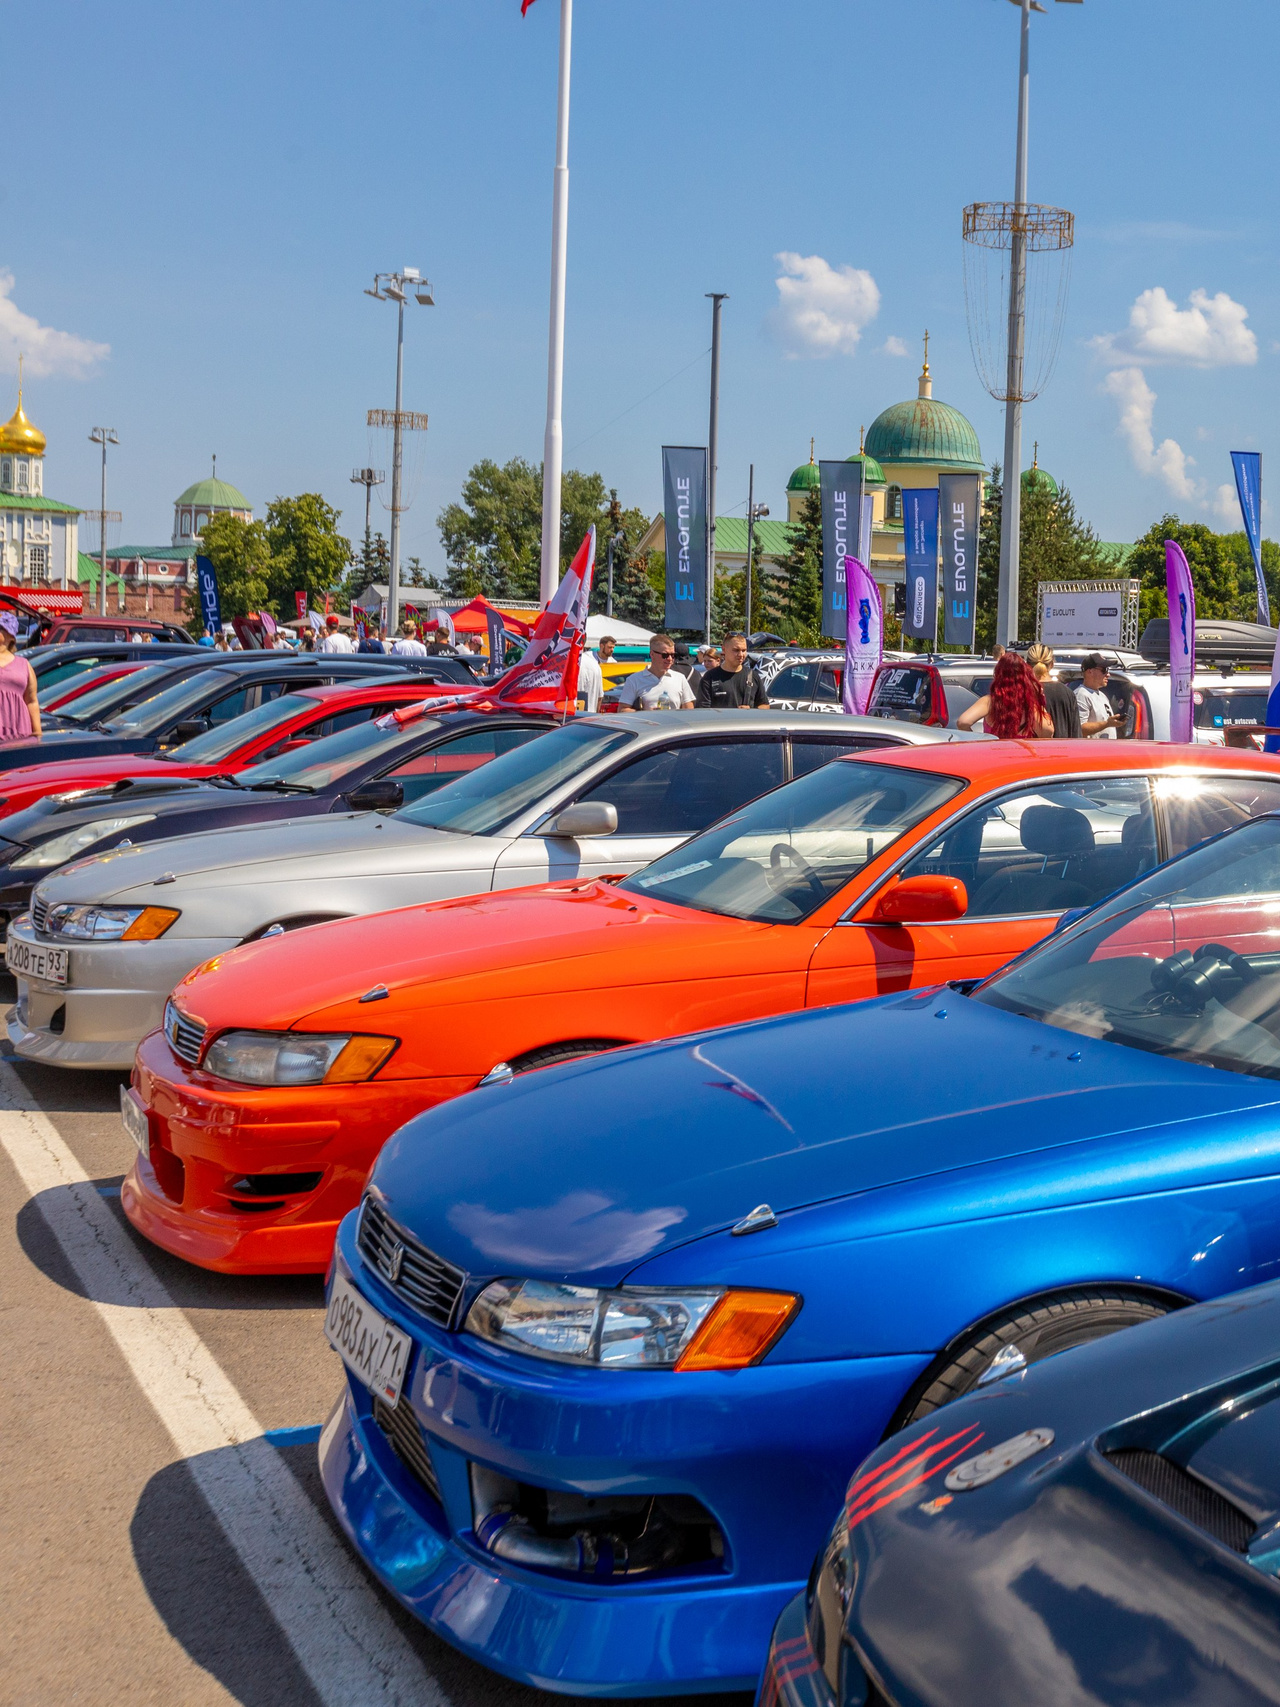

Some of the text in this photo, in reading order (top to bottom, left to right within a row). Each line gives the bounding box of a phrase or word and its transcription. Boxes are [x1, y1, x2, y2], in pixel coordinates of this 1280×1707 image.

[1053, 608, 1075, 616] EVOLUTE
[48, 951, 62, 972] 93
[379, 1330, 401, 1378] 71
